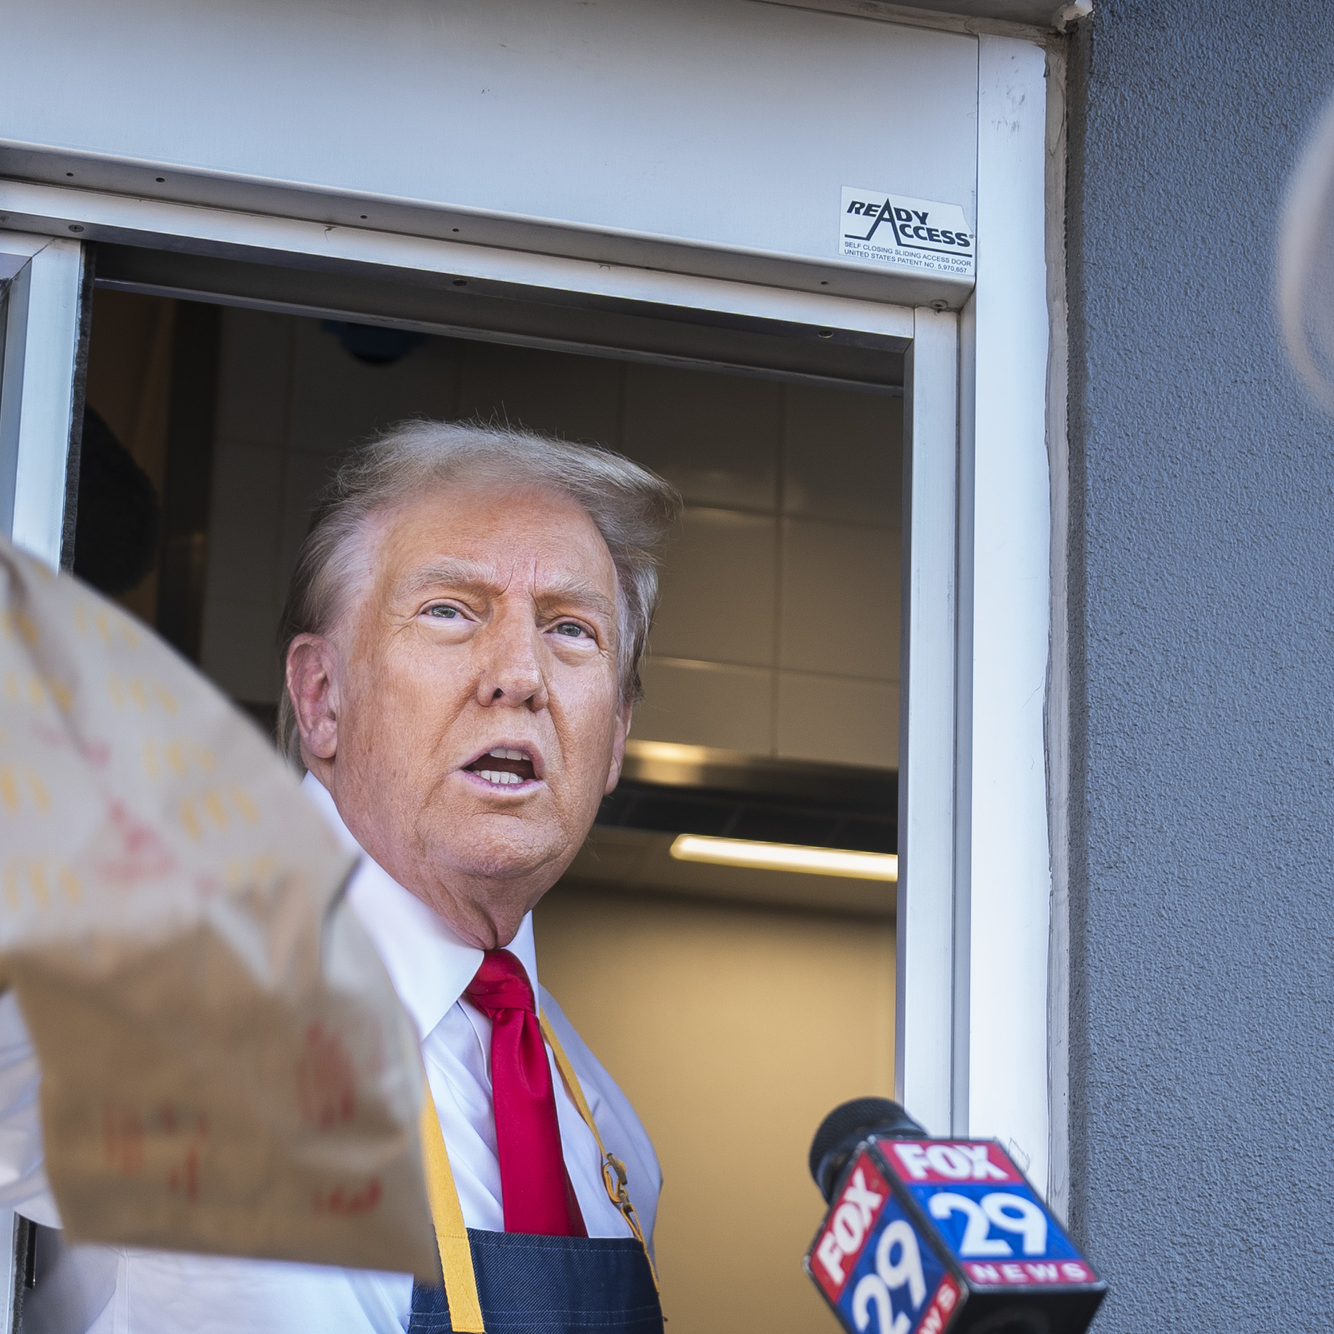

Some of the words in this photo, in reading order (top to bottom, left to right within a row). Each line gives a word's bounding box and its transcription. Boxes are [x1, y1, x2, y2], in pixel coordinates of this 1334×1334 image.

[847, 198, 929, 225] READY
[844, 249, 869, 258] UNITED
[871, 252, 896, 262] STATES
[897, 257, 923, 267] PATENT
[924, 261, 937, 269] NO.
[845, 241, 861, 249] SELF
[863, 244, 893, 254] CLOSING
[895, 248, 921, 258] SLIDING
[922, 253, 950, 264] ACCESS
[951, 258, 971, 267] DOOR
[893, 1143, 1009, 1180] FOX
[817, 1167, 883, 1287] FOX
[928, 1192, 1047, 1257] 29
[972, 1263, 1087, 1283] NEWS
